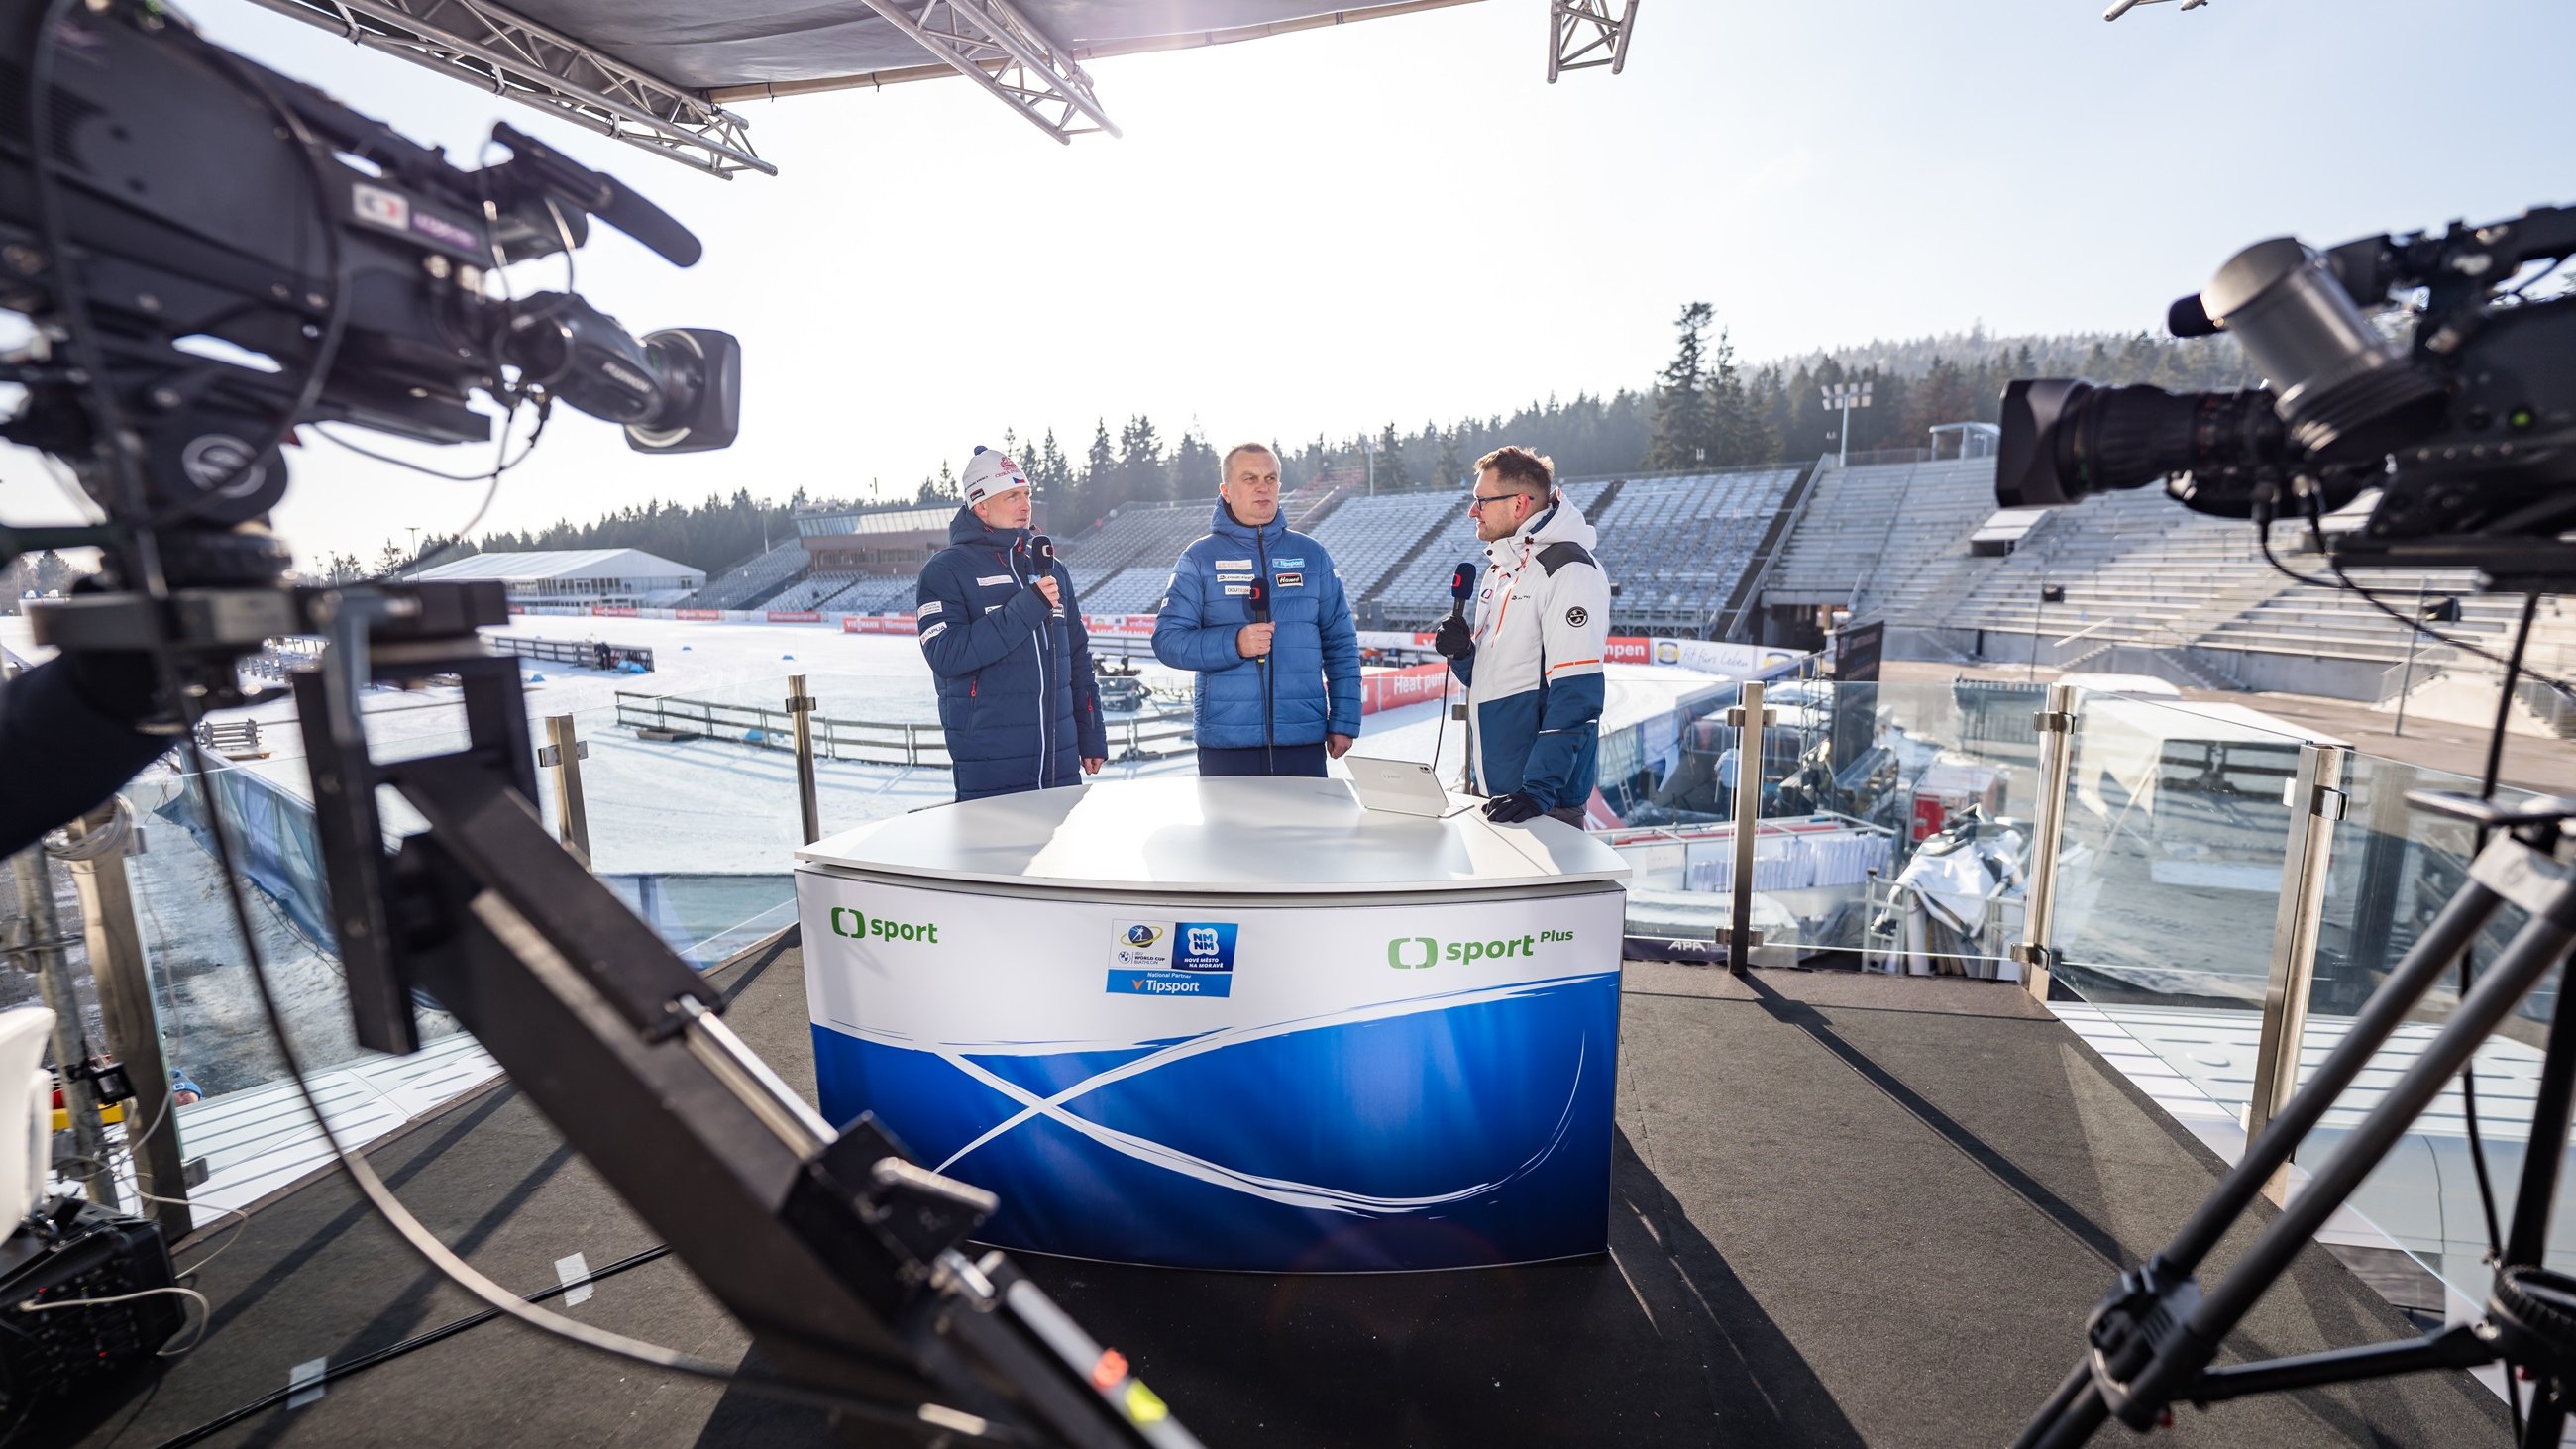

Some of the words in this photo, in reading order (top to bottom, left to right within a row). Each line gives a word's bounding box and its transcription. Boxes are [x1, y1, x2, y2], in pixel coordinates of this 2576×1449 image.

[1394, 675, 1422, 695] Heat
[871, 919, 938, 943] sport
[1193, 933, 1214, 942] NM
[1194, 941, 1215, 951] NM
[1446, 934, 1535, 965] sport
[1540, 929, 1574, 943] Plus
[1668, 941, 1706, 952] APA
[1146, 980, 1200, 993] Tipsport
